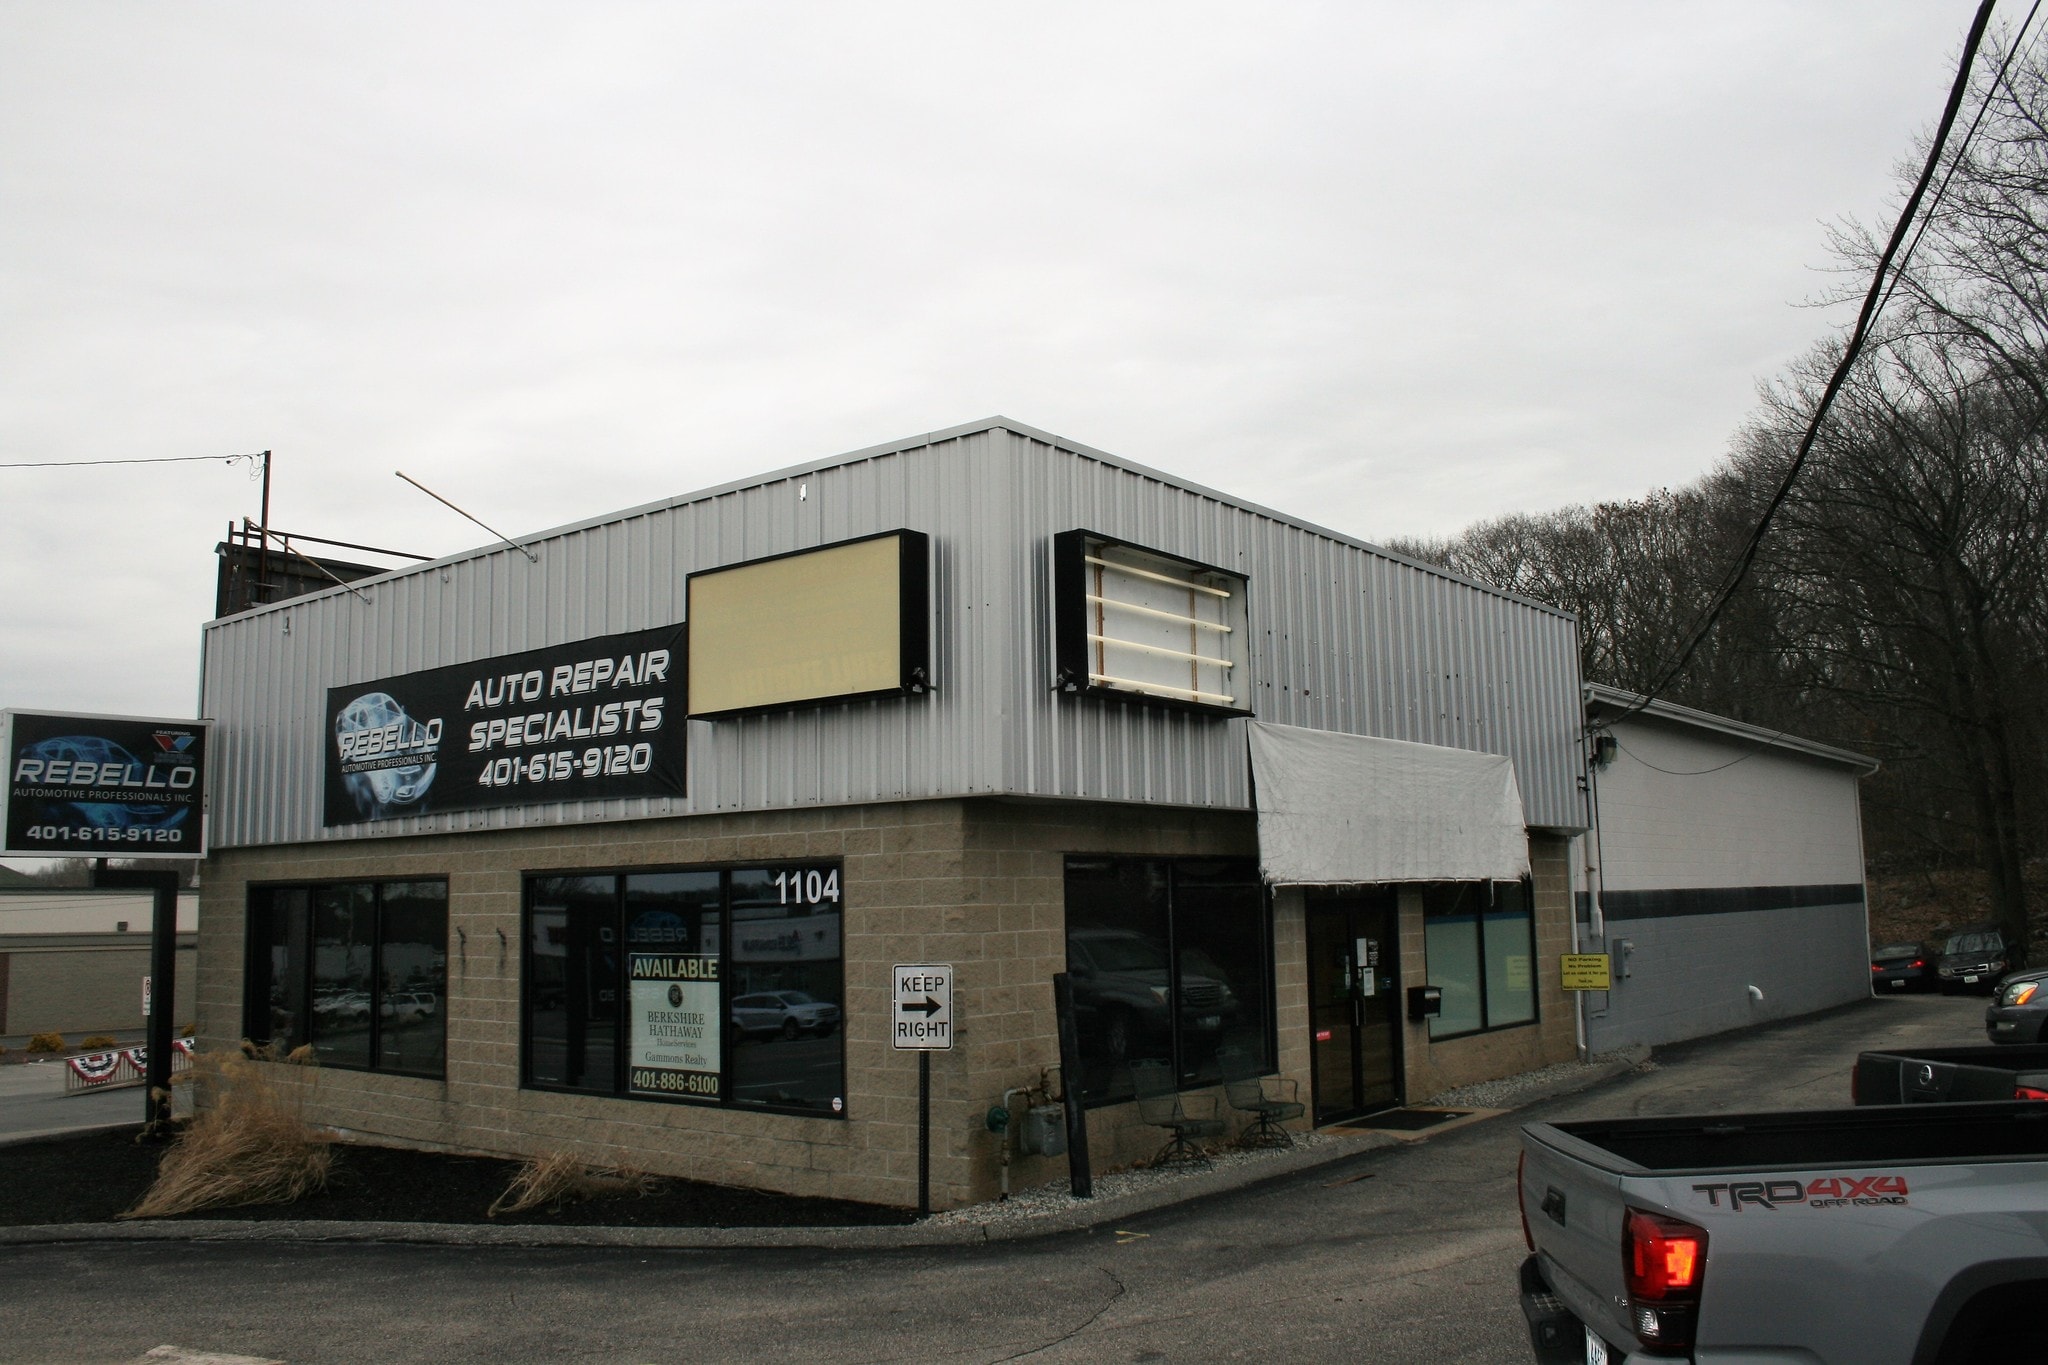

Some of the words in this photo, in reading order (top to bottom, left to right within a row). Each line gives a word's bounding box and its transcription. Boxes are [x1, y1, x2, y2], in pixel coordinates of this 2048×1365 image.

[464, 669, 544, 711] AUTO
[550, 649, 670, 698] REPAIR
[468, 697, 665, 752] SPECIALISTS
[340, 717, 443, 758] REBELLO
[341, 761, 377, 773] AUTOMOTIVE
[377, 754, 424, 768] PROFESSIONALS
[478, 743, 653, 787] 401-615-9120
[14, 758, 196, 789] REBELLO
[13, 787, 85, 800] AUTOMOTIVE
[89, 790, 172, 802] PROFESSIONALS
[27, 825, 182, 843] 401-615-9120
[774, 868, 840, 905] 1104
[633, 958, 718, 979] AVAILABLE
[901, 976, 945, 992] KEEP
[647, 1010, 705, 1025] BERKSHIRE
[649, 1024, 704, 1039] HATHAWAY
[898, 1021, 948, 1037] RIGHT
[656, 1038, 697, 1049] HomeServices
[645, 1051, 683, 1064] Gammons
[684, 1054, 708, 1068] Realty
[633, 1070, 719, 1094] 401-886-6100
[1692, 1180, 1808, 1212] TRD
[1809, 1197, 1849, 1208] OFF
[1852, 1196, 1908, 1206] ROAD
